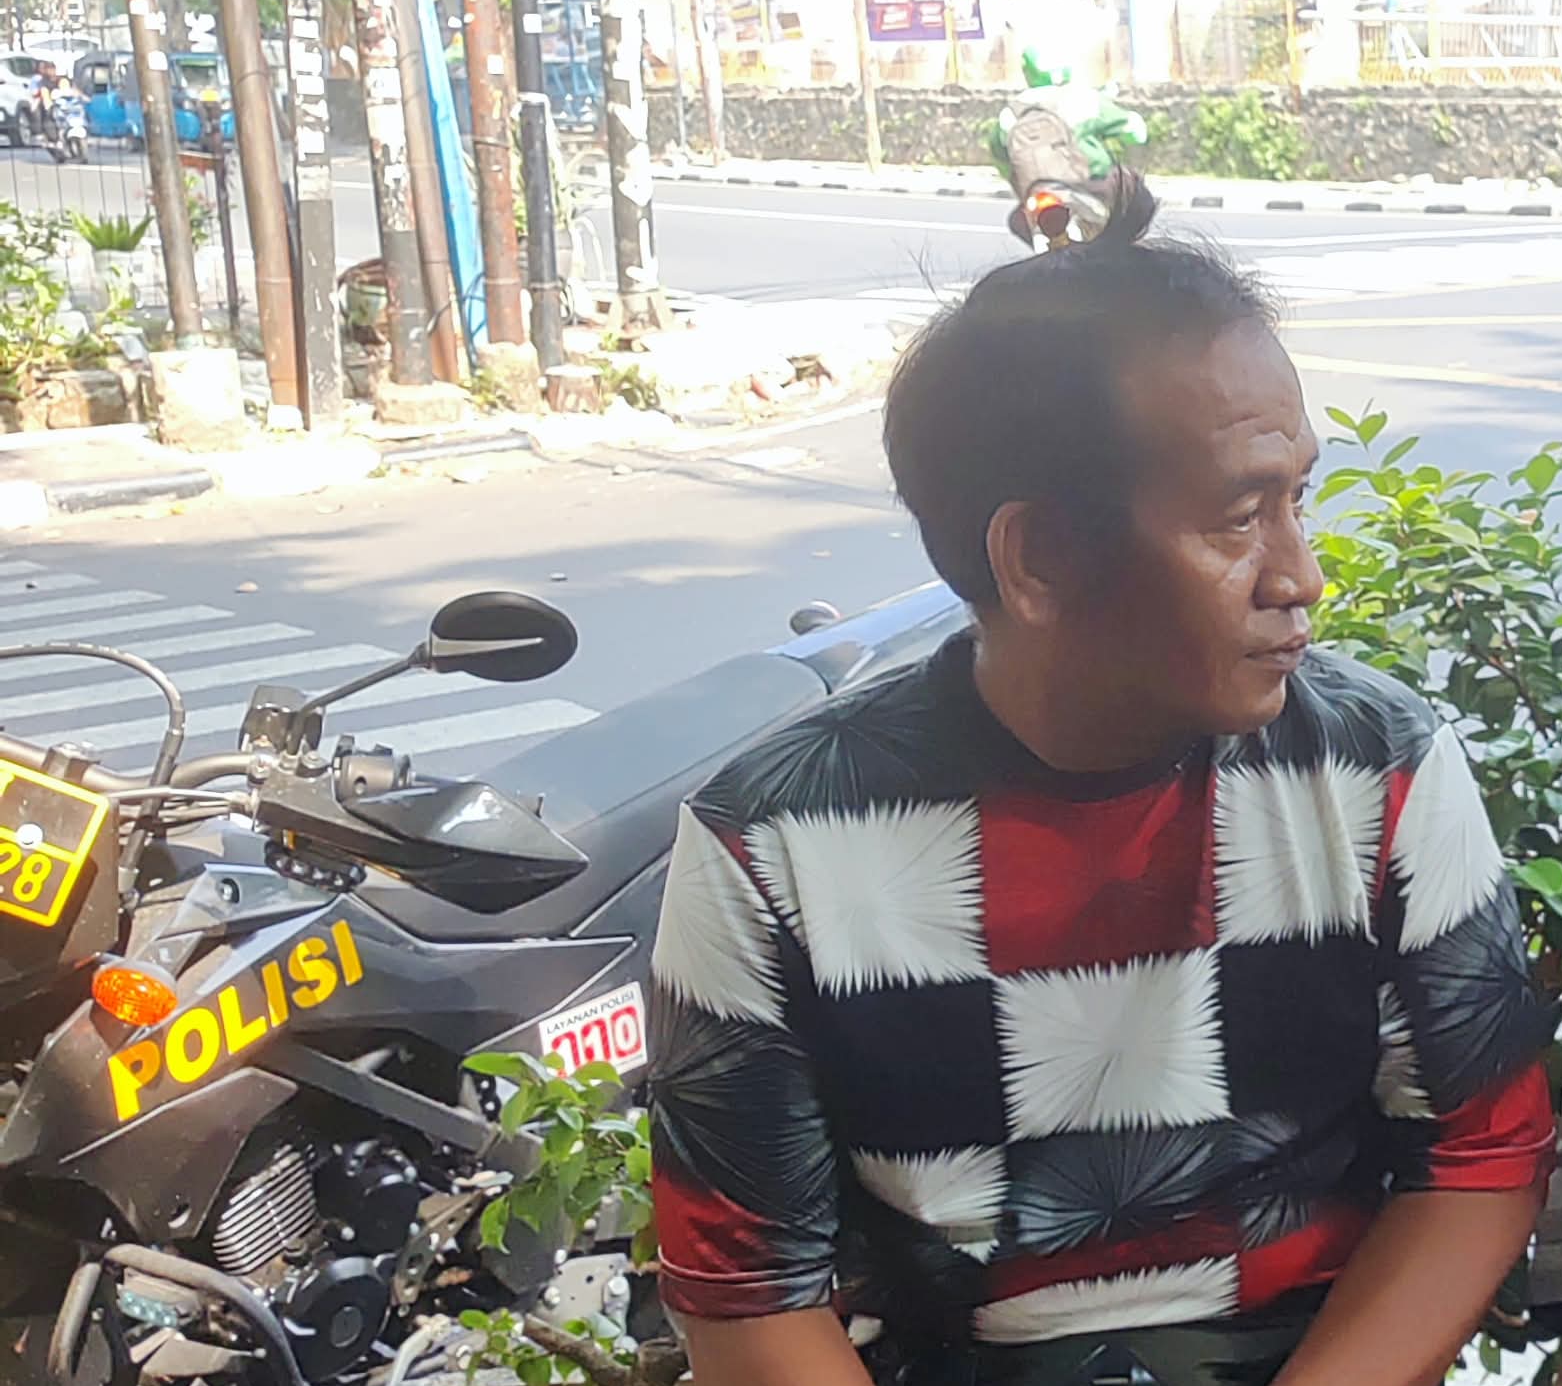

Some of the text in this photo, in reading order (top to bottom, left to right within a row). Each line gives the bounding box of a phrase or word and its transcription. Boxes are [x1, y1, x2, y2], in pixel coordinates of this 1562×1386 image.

[107, 918, 364, 1121] POLISI
[546, 990, 635, 1035] LAYANAN POLISI
[551, 1005, 642, 1078] 110
